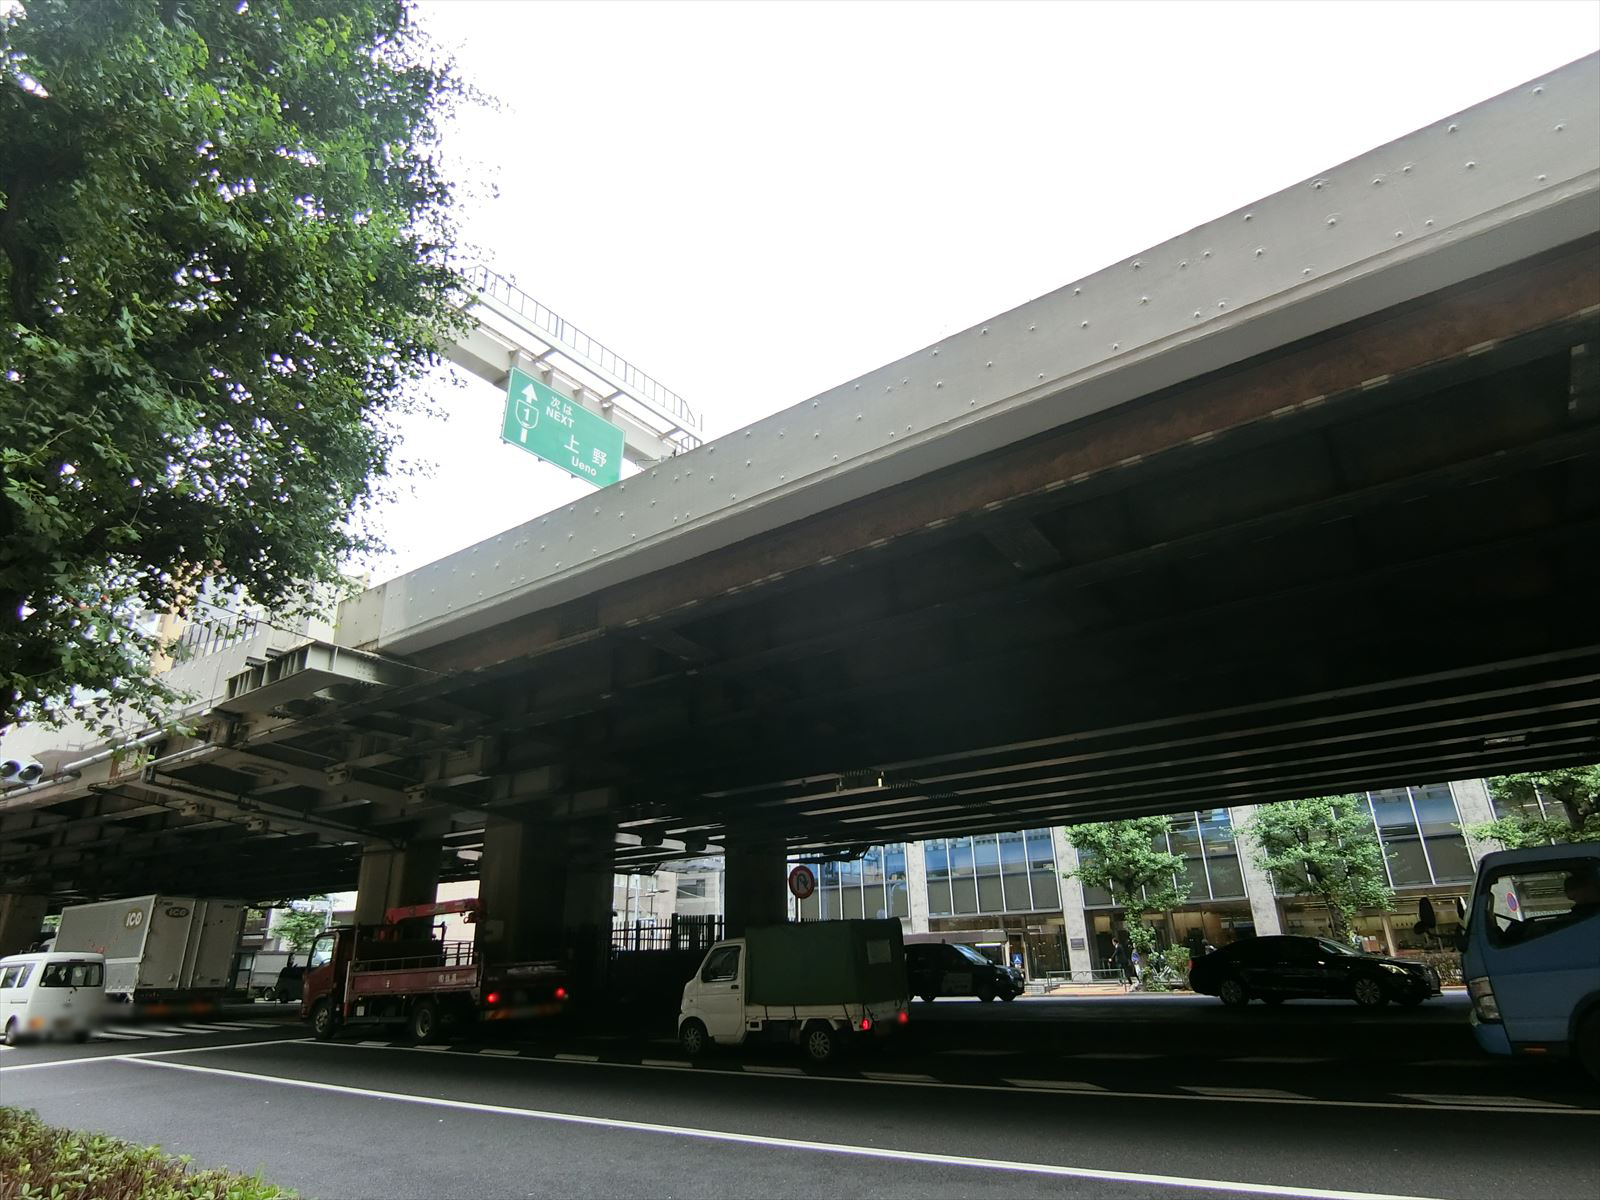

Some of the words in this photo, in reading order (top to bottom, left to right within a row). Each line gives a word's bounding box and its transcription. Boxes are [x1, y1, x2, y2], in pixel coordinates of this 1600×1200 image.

[523, 407, 530, 422] 1
[550, 396, 573, 416] 次は
[545, 406, 575, 428] NEXT
[564, 434, 607, 467] 上野
[571, 456, 597, 476] Ueno
[126, 911, 142, 927] ICO
